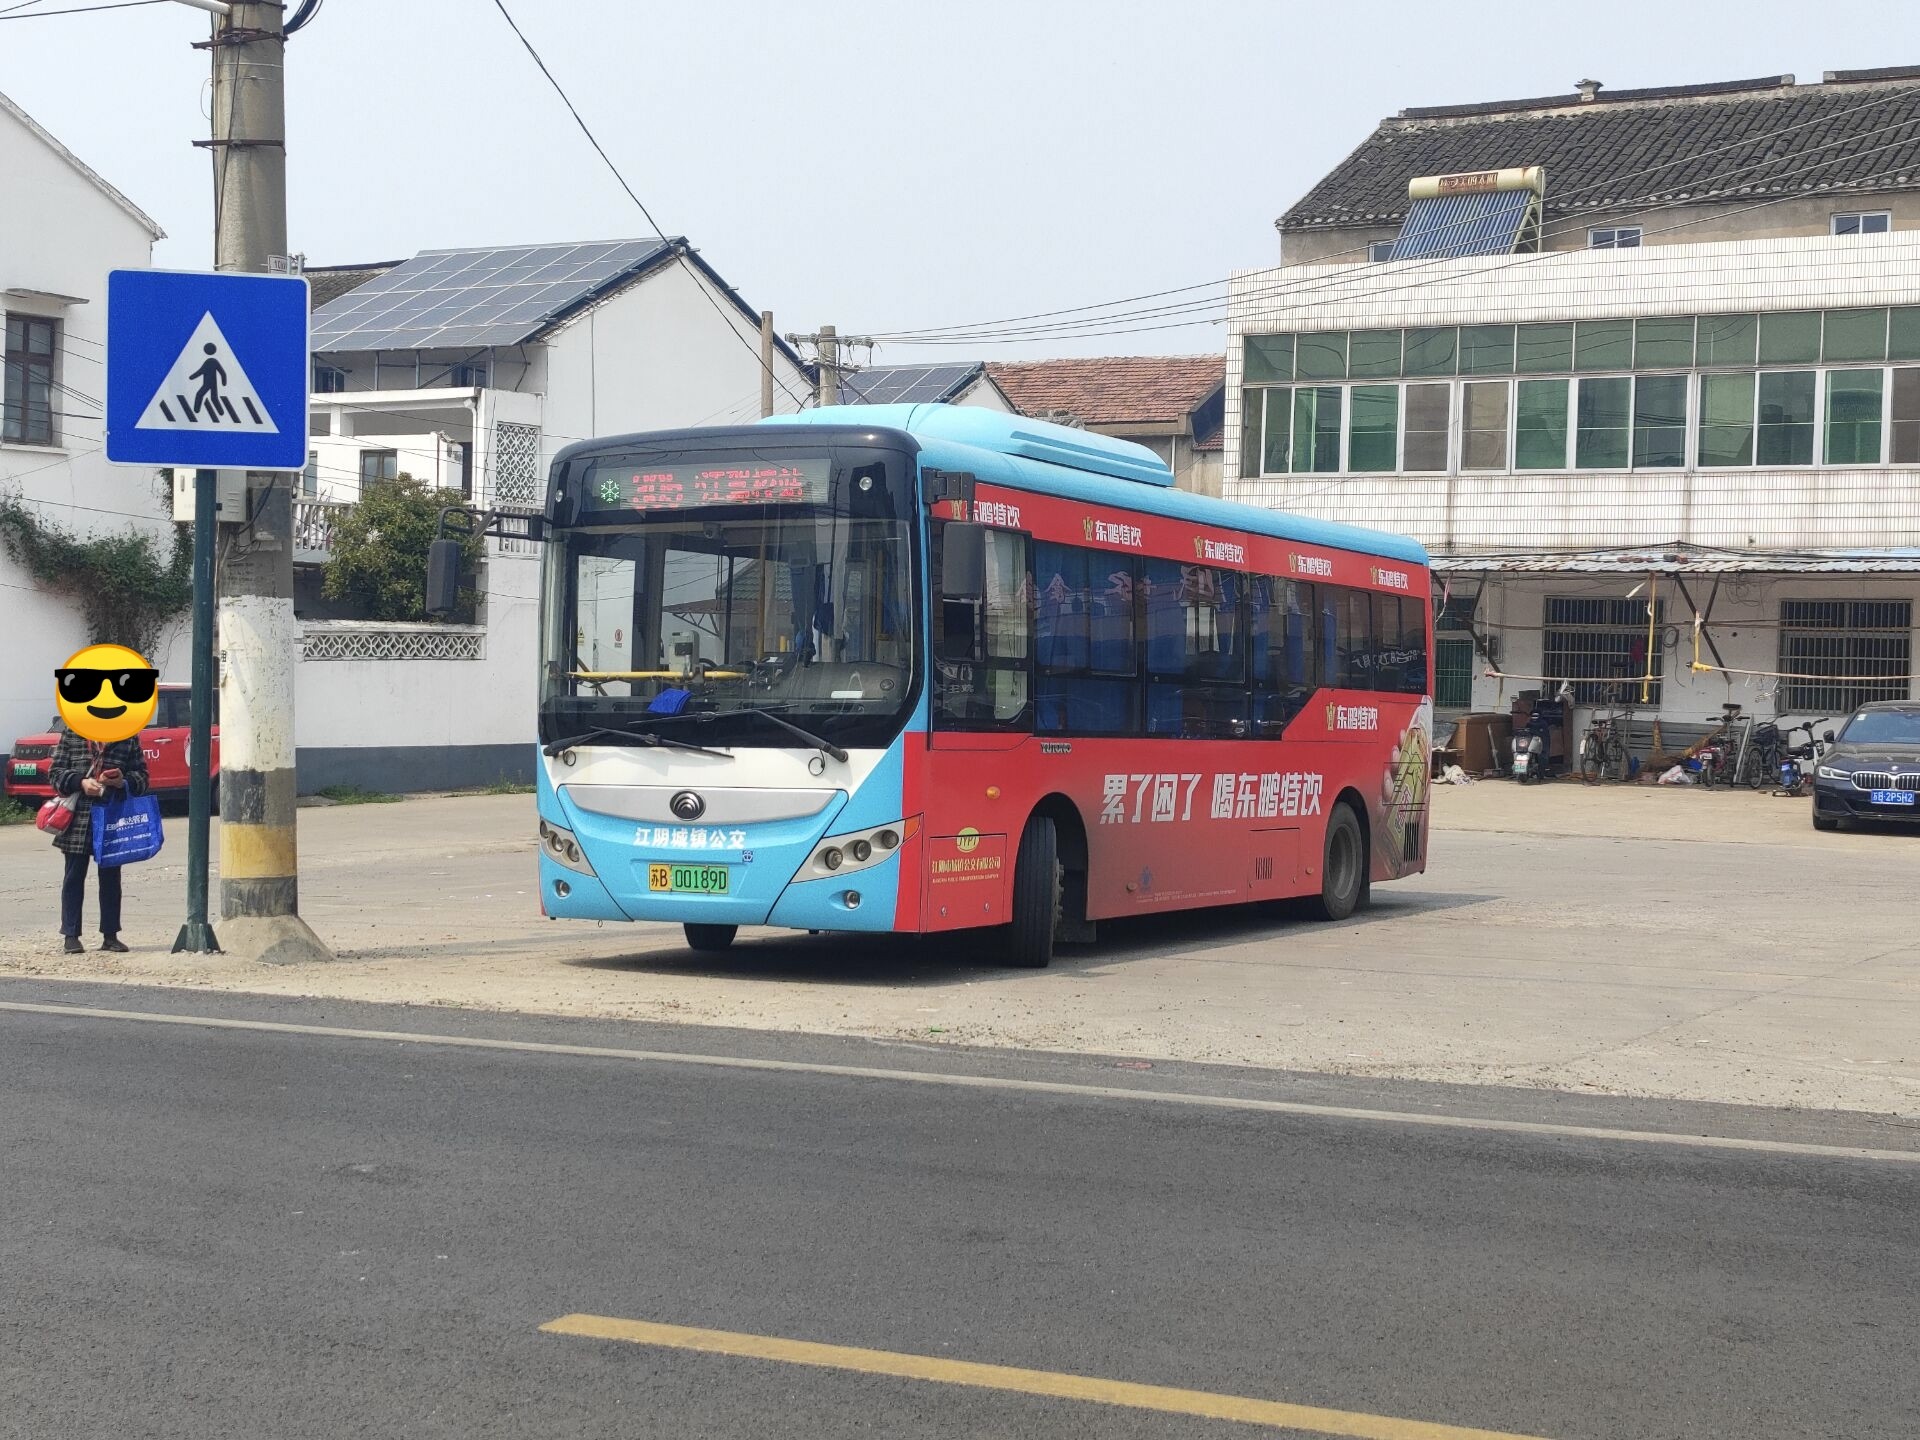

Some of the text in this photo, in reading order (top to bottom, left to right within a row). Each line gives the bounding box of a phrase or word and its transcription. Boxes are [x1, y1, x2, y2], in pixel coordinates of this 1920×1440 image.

[1095, 520, 1142, 547] 东鹏特饮
[1204, 540, 1244, 564] 东鹏特饮
[1297, 554, 1332, 577] 东鹏特饮
[1378, 567, 1409, 590] 东鹏特饮
[1337, 705, 1378, 730] 东鹏特饮
[1100, 771, 1323, 824] 累了困了 喝东鹏特饮
[633, 827, 747, 849] 江阴城镇公交
[675, 869, 727, 890] 00189D
